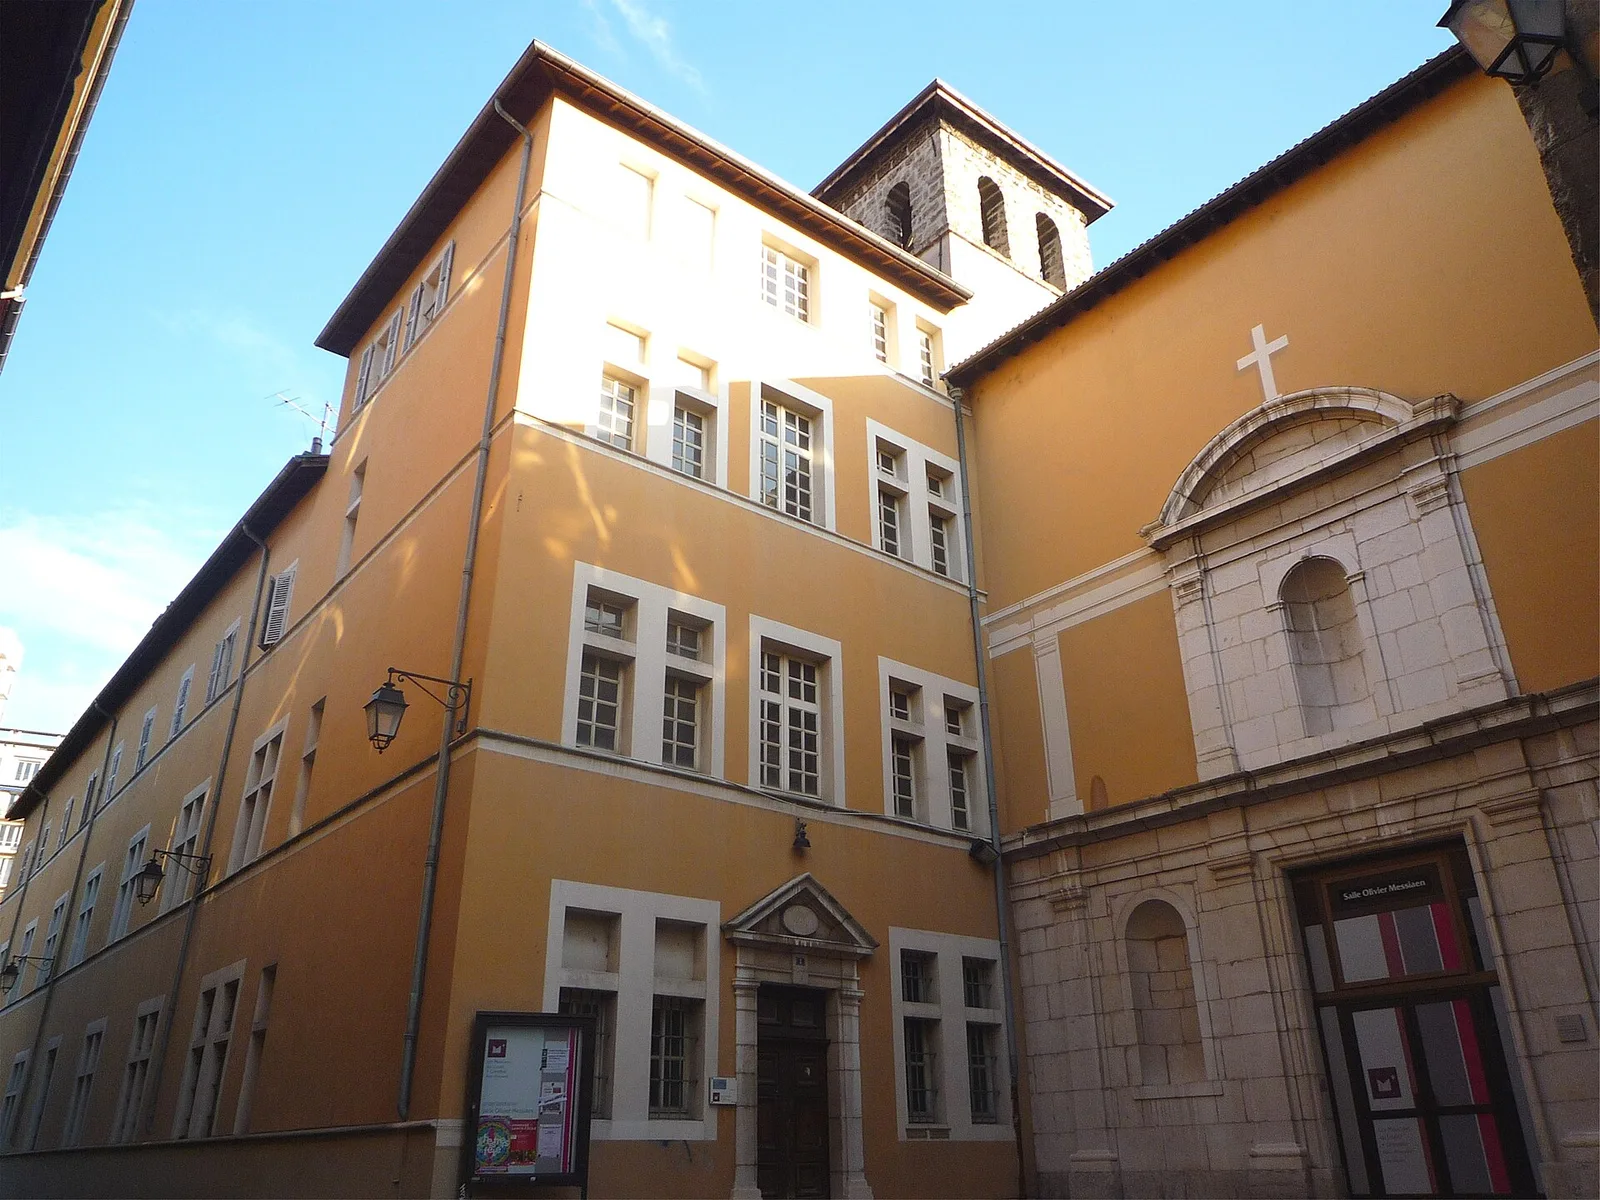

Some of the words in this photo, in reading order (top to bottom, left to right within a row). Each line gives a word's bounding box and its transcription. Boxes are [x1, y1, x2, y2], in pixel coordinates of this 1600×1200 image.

[1343, 890, 1361, 901] Salle
[1362, 886, 1387, 897] Olivier
[1388, 880, 1426, 892] Messiaen
